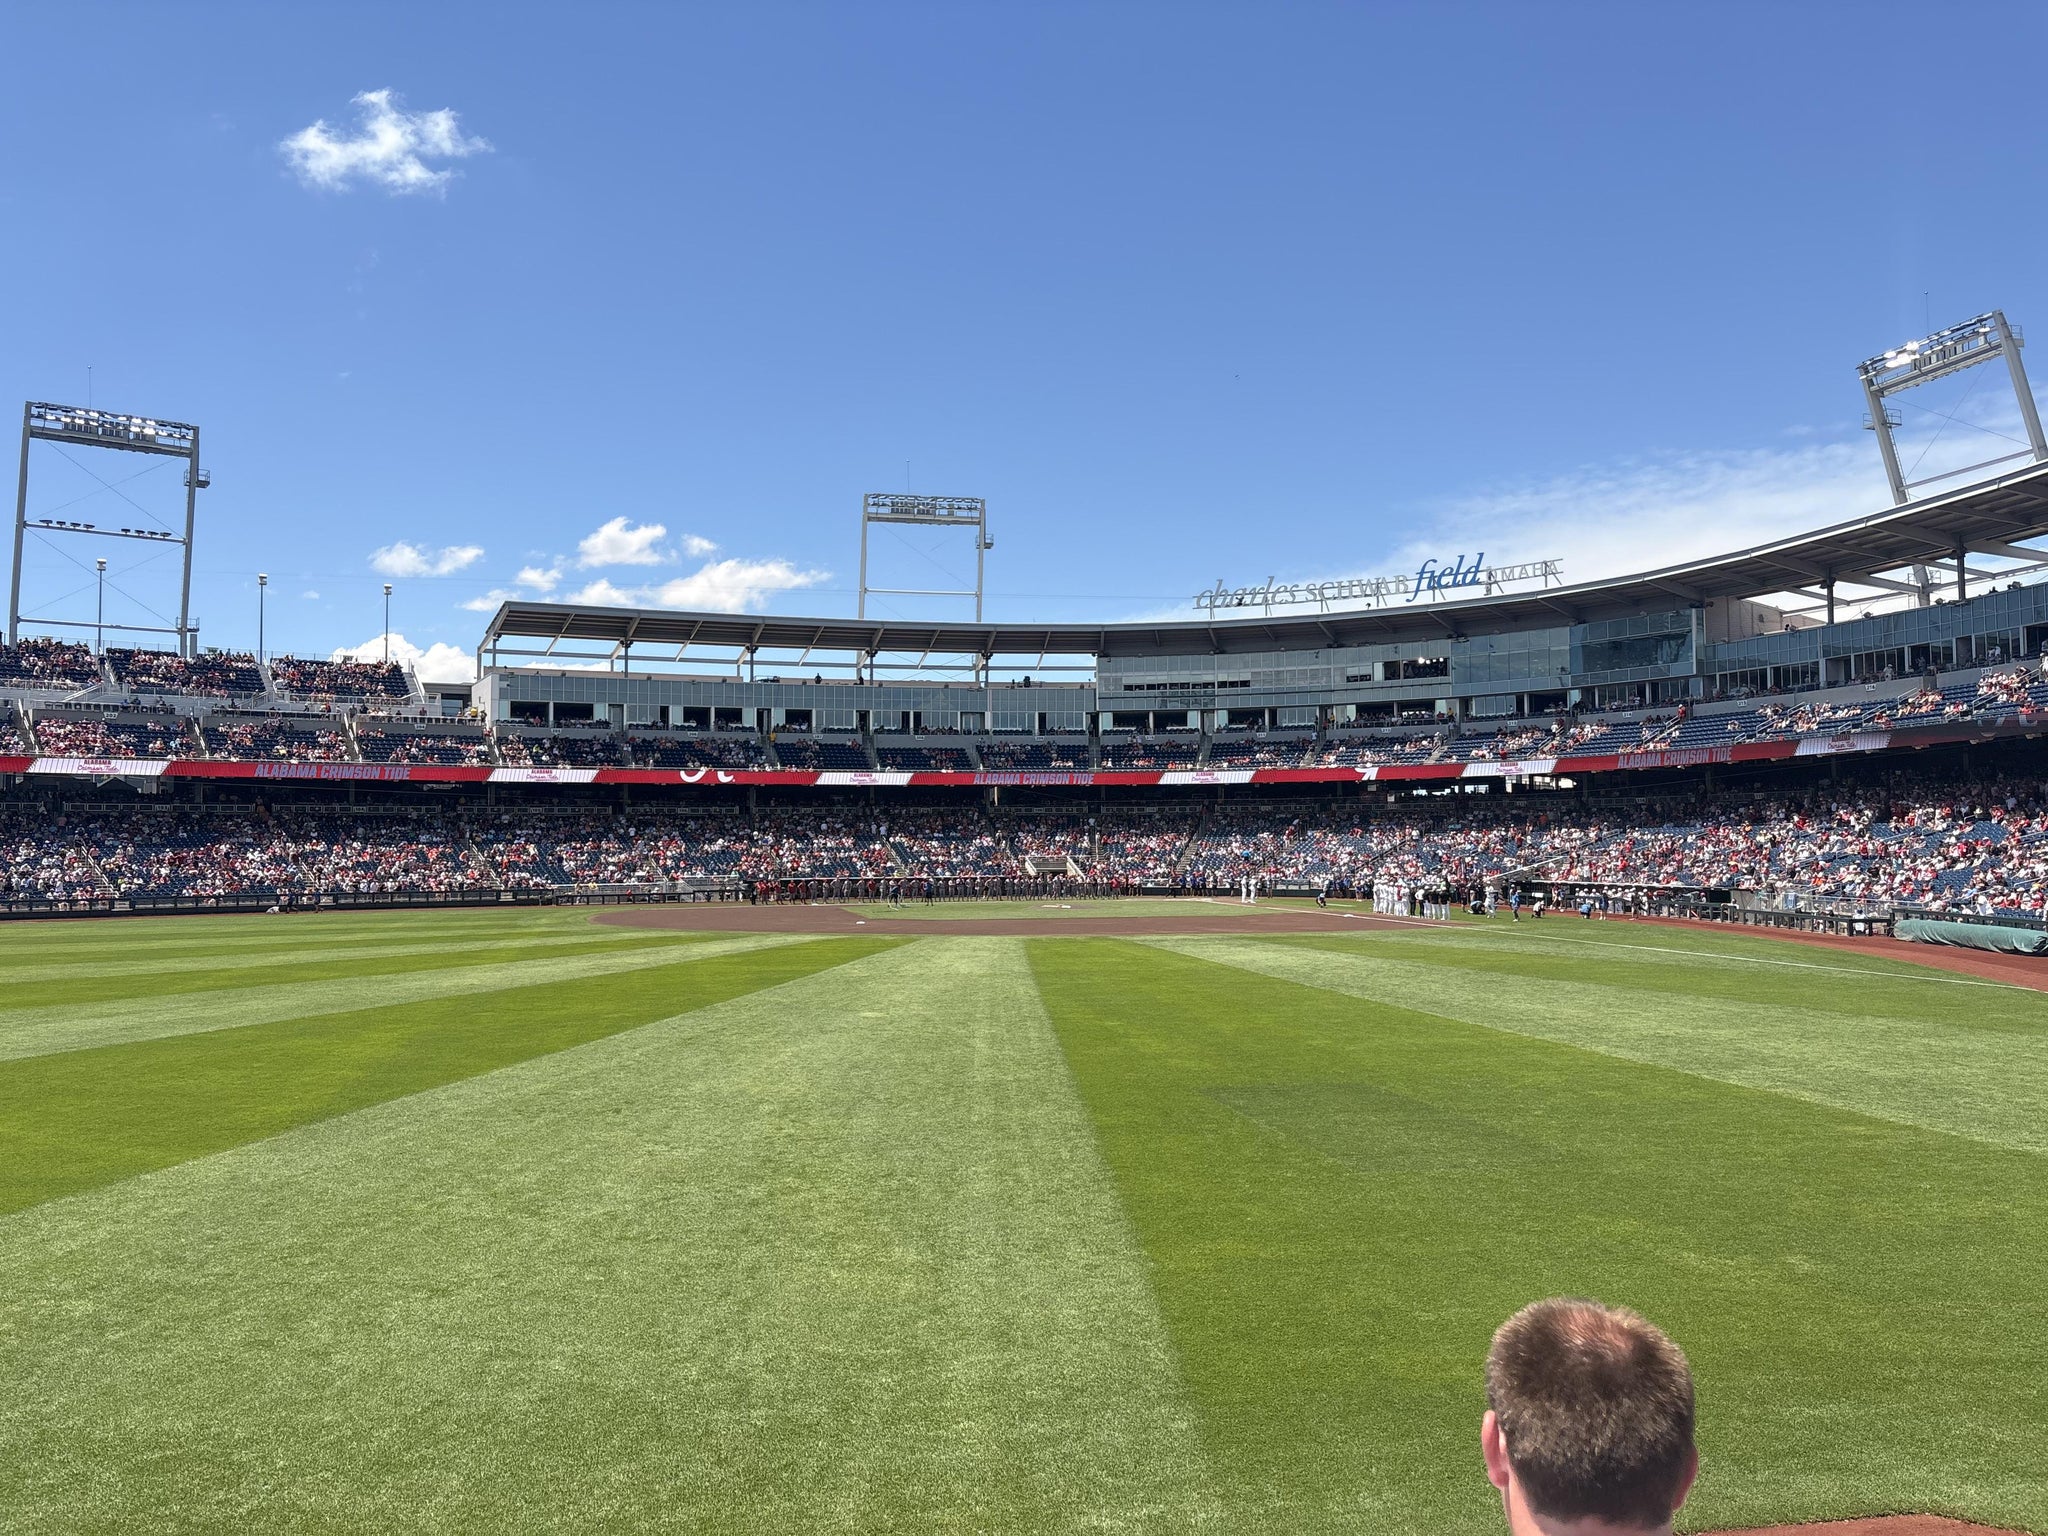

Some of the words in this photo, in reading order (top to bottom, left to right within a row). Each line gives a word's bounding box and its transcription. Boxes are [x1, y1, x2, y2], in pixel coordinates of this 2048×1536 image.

[1196, 576, 1300, 609] charles
[1305, 574, 1409, 602] SCHWAB
[1406, 552, 1484, 602] field
[1487, 560, 1559, 583] OMAHA
[1617, 752, 1661, 769] ALABAMA
[1663, 749, 1709, 766] CRIMSON
[1712, 747, 1731, 763] TIDE
[255, 764, 317, 778] ALABAMA
[320, 765, 381, 779] CRIMSON
[383, 767, 411, 780] TIDE
[973, 774, 1020, 785] ALABAMA
[1022, 774, 1070, 785] CRIMSON
[1073, 773, 1094, 785] TIDE
